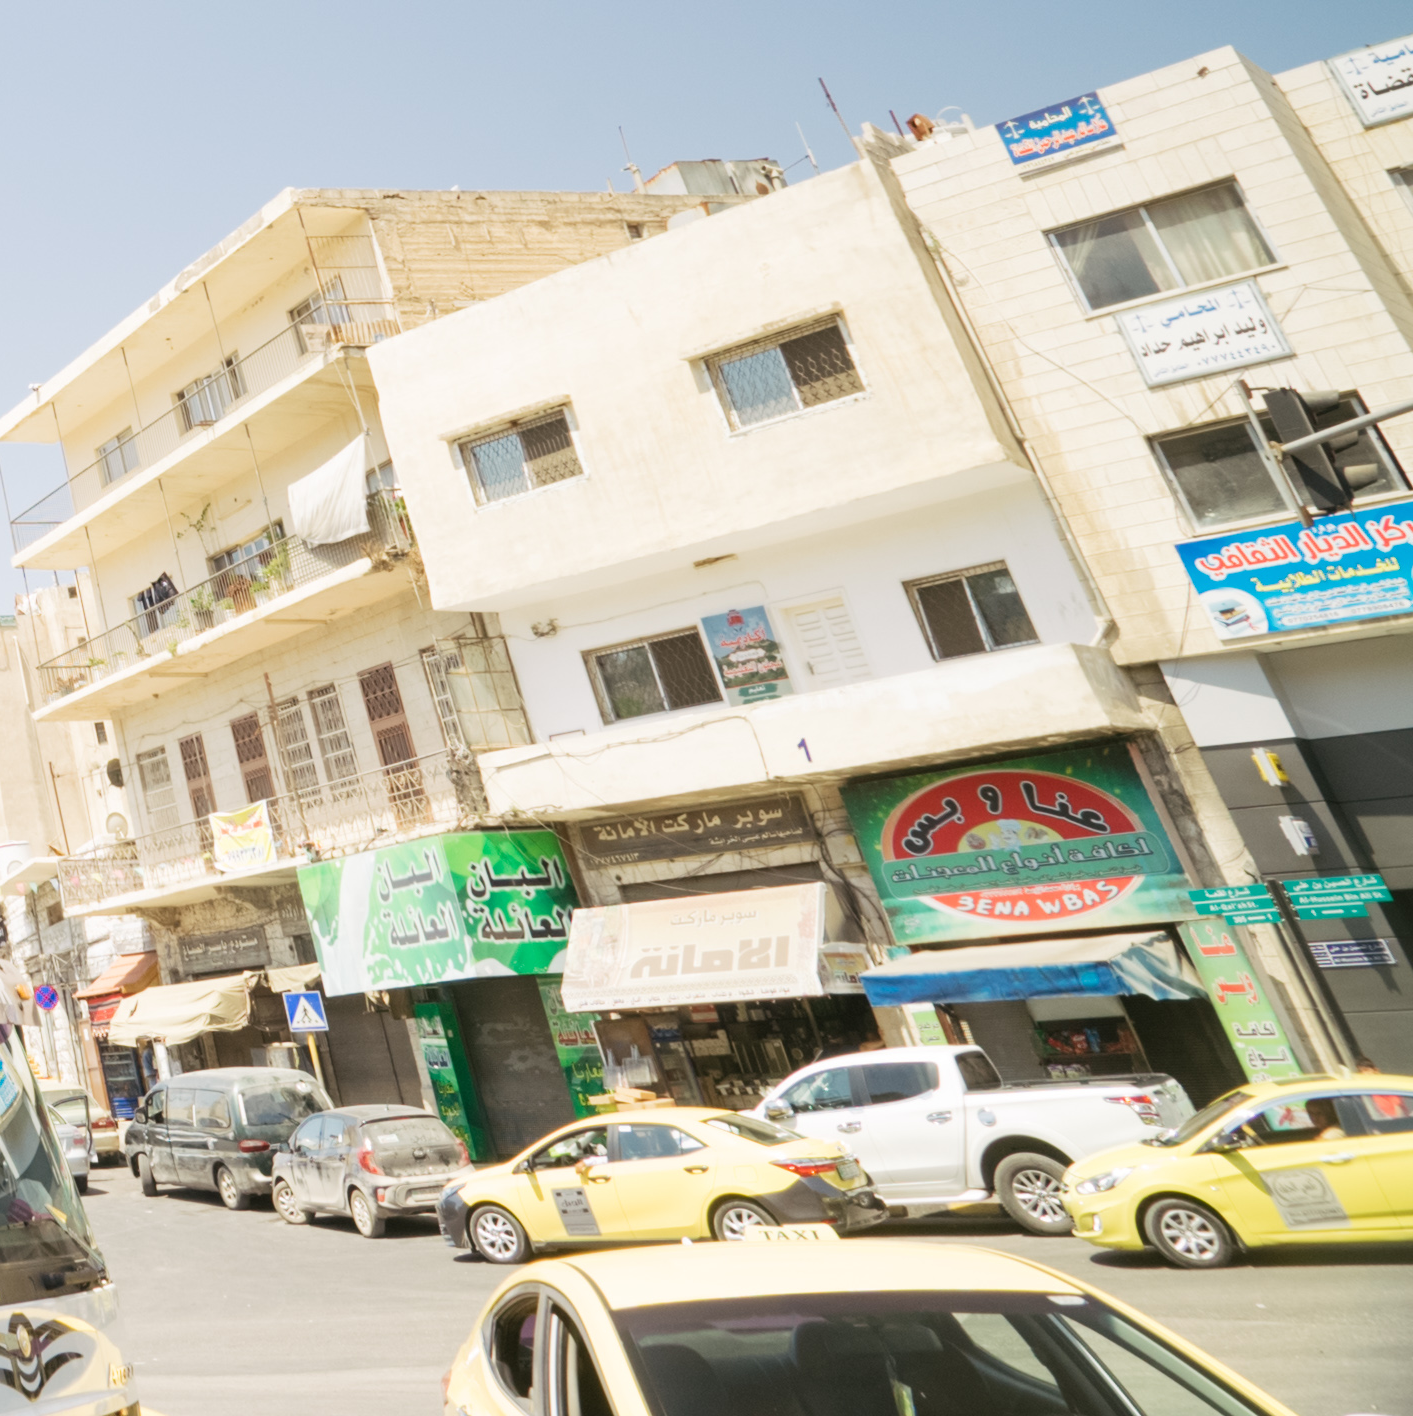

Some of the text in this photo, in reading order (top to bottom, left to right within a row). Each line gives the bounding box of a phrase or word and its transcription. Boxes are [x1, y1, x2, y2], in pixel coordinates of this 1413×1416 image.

[1161, 297, 1220, 328] المحامي
[1234, 316, 1268, 338] وليد
[1140, 341, 1171, 358] حداد
[1195, 535, 1301, 581] الثقافي
[661, 811, 722, 834] ماركت
[733, 807, 783, 828] سوبر
[901, 780, 1111, 856] عنا و بس
[1001, 844, 1066, 875] أنواع
[1069, 838, 1153, 863] لكافة
[377, 847, 442, 902] البان
[468, 856, 565, 899] البان
[891, 855, 997, 883] المعجنات
[382, 901, 459, 947] العائلة
[670, 909, 757, 929] سوبر ماركت
[759, 1230, 819, 1240] TAXI
